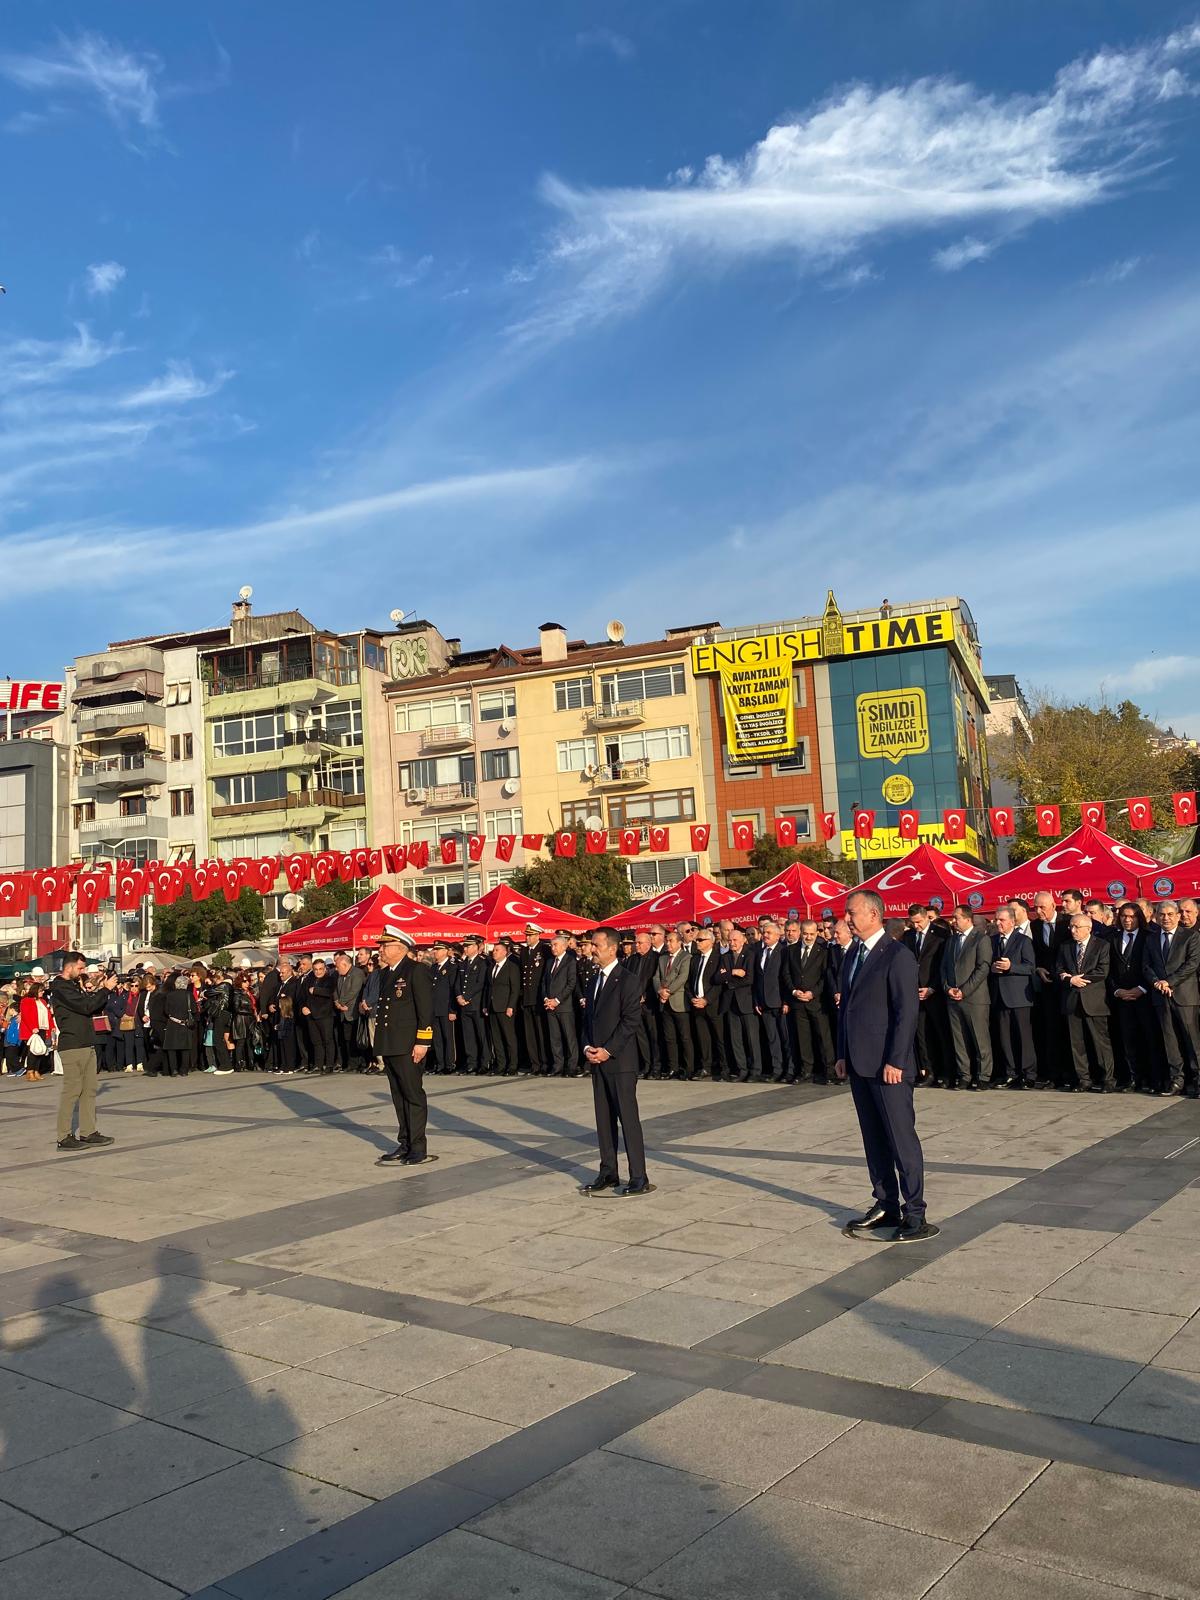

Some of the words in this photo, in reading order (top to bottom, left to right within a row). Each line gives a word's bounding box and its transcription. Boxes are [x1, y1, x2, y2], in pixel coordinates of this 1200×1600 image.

[847, 614, 944, 652] TIME
[732, 666, 780, 682] AVANTAJLI
[753, 678, 790, 693] ZAMANI
[0, 683, 62, 709] IFE
[739, 693, 779, 708] BAŞLADI
